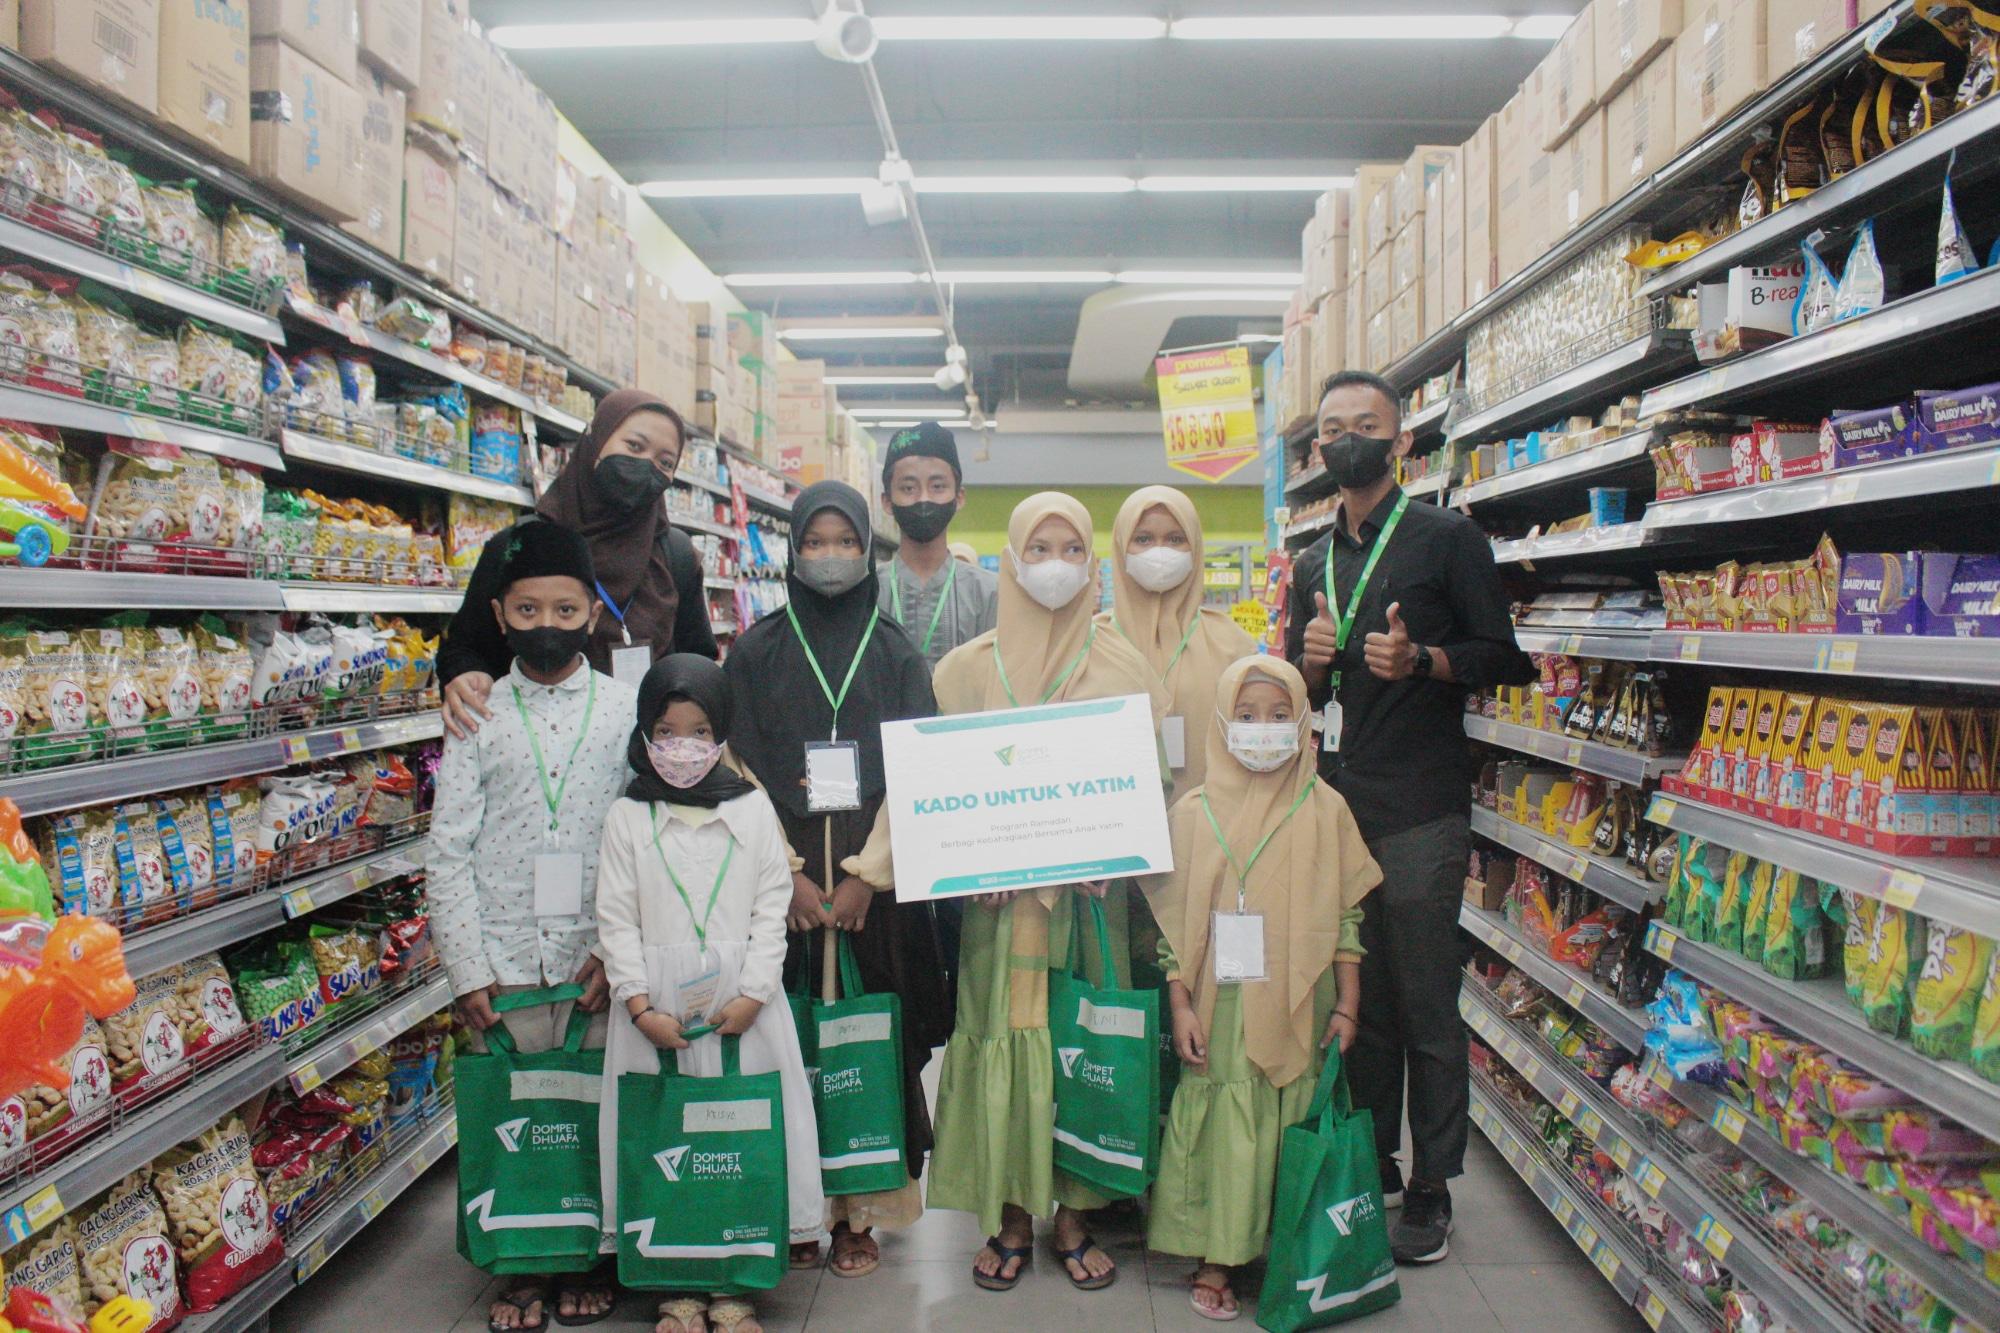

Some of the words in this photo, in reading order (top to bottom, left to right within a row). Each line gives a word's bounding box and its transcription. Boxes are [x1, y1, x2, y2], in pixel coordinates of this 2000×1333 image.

[1934, 406, 1960, 421] DAIRY
[1960, 402, 1982, 417] MILK
[1842, 428, 1863, 442] DAIRY
[1863, 425, 1881, 438] MILK
[1842, 579, 1863, 590] DAIRY
[1863, 579, 1883, 591] MILK
[1951, 582, 1977, 594] DAIRY
[913, 793, 979, 816] KADO
[985, 783, 1062, 808] UNTUK
[1067, 775, 1137, 797] YATIM
[990, 821, 1028, 833] Program
[1030, 816, 1071, 828] Ramadan
[940, 839, 975, 850] Berbagi
[1034, 828, 1073, 839] Bersama
[1074, 824, 1097, 833] Anak
[1099, 821, 1124, 831] Yatim
[823, 1067, 861, 1084] DOMPET
[823, 1077, 863, 1094] DHUAFA
[532, 1123, 579, 1135] DOMPET
[532, 1134, 580, 1145] DHUAFA
[692, 1152, 742, 1164] DOMPET
[692, 1163, 742, 1174] DHUAFA
